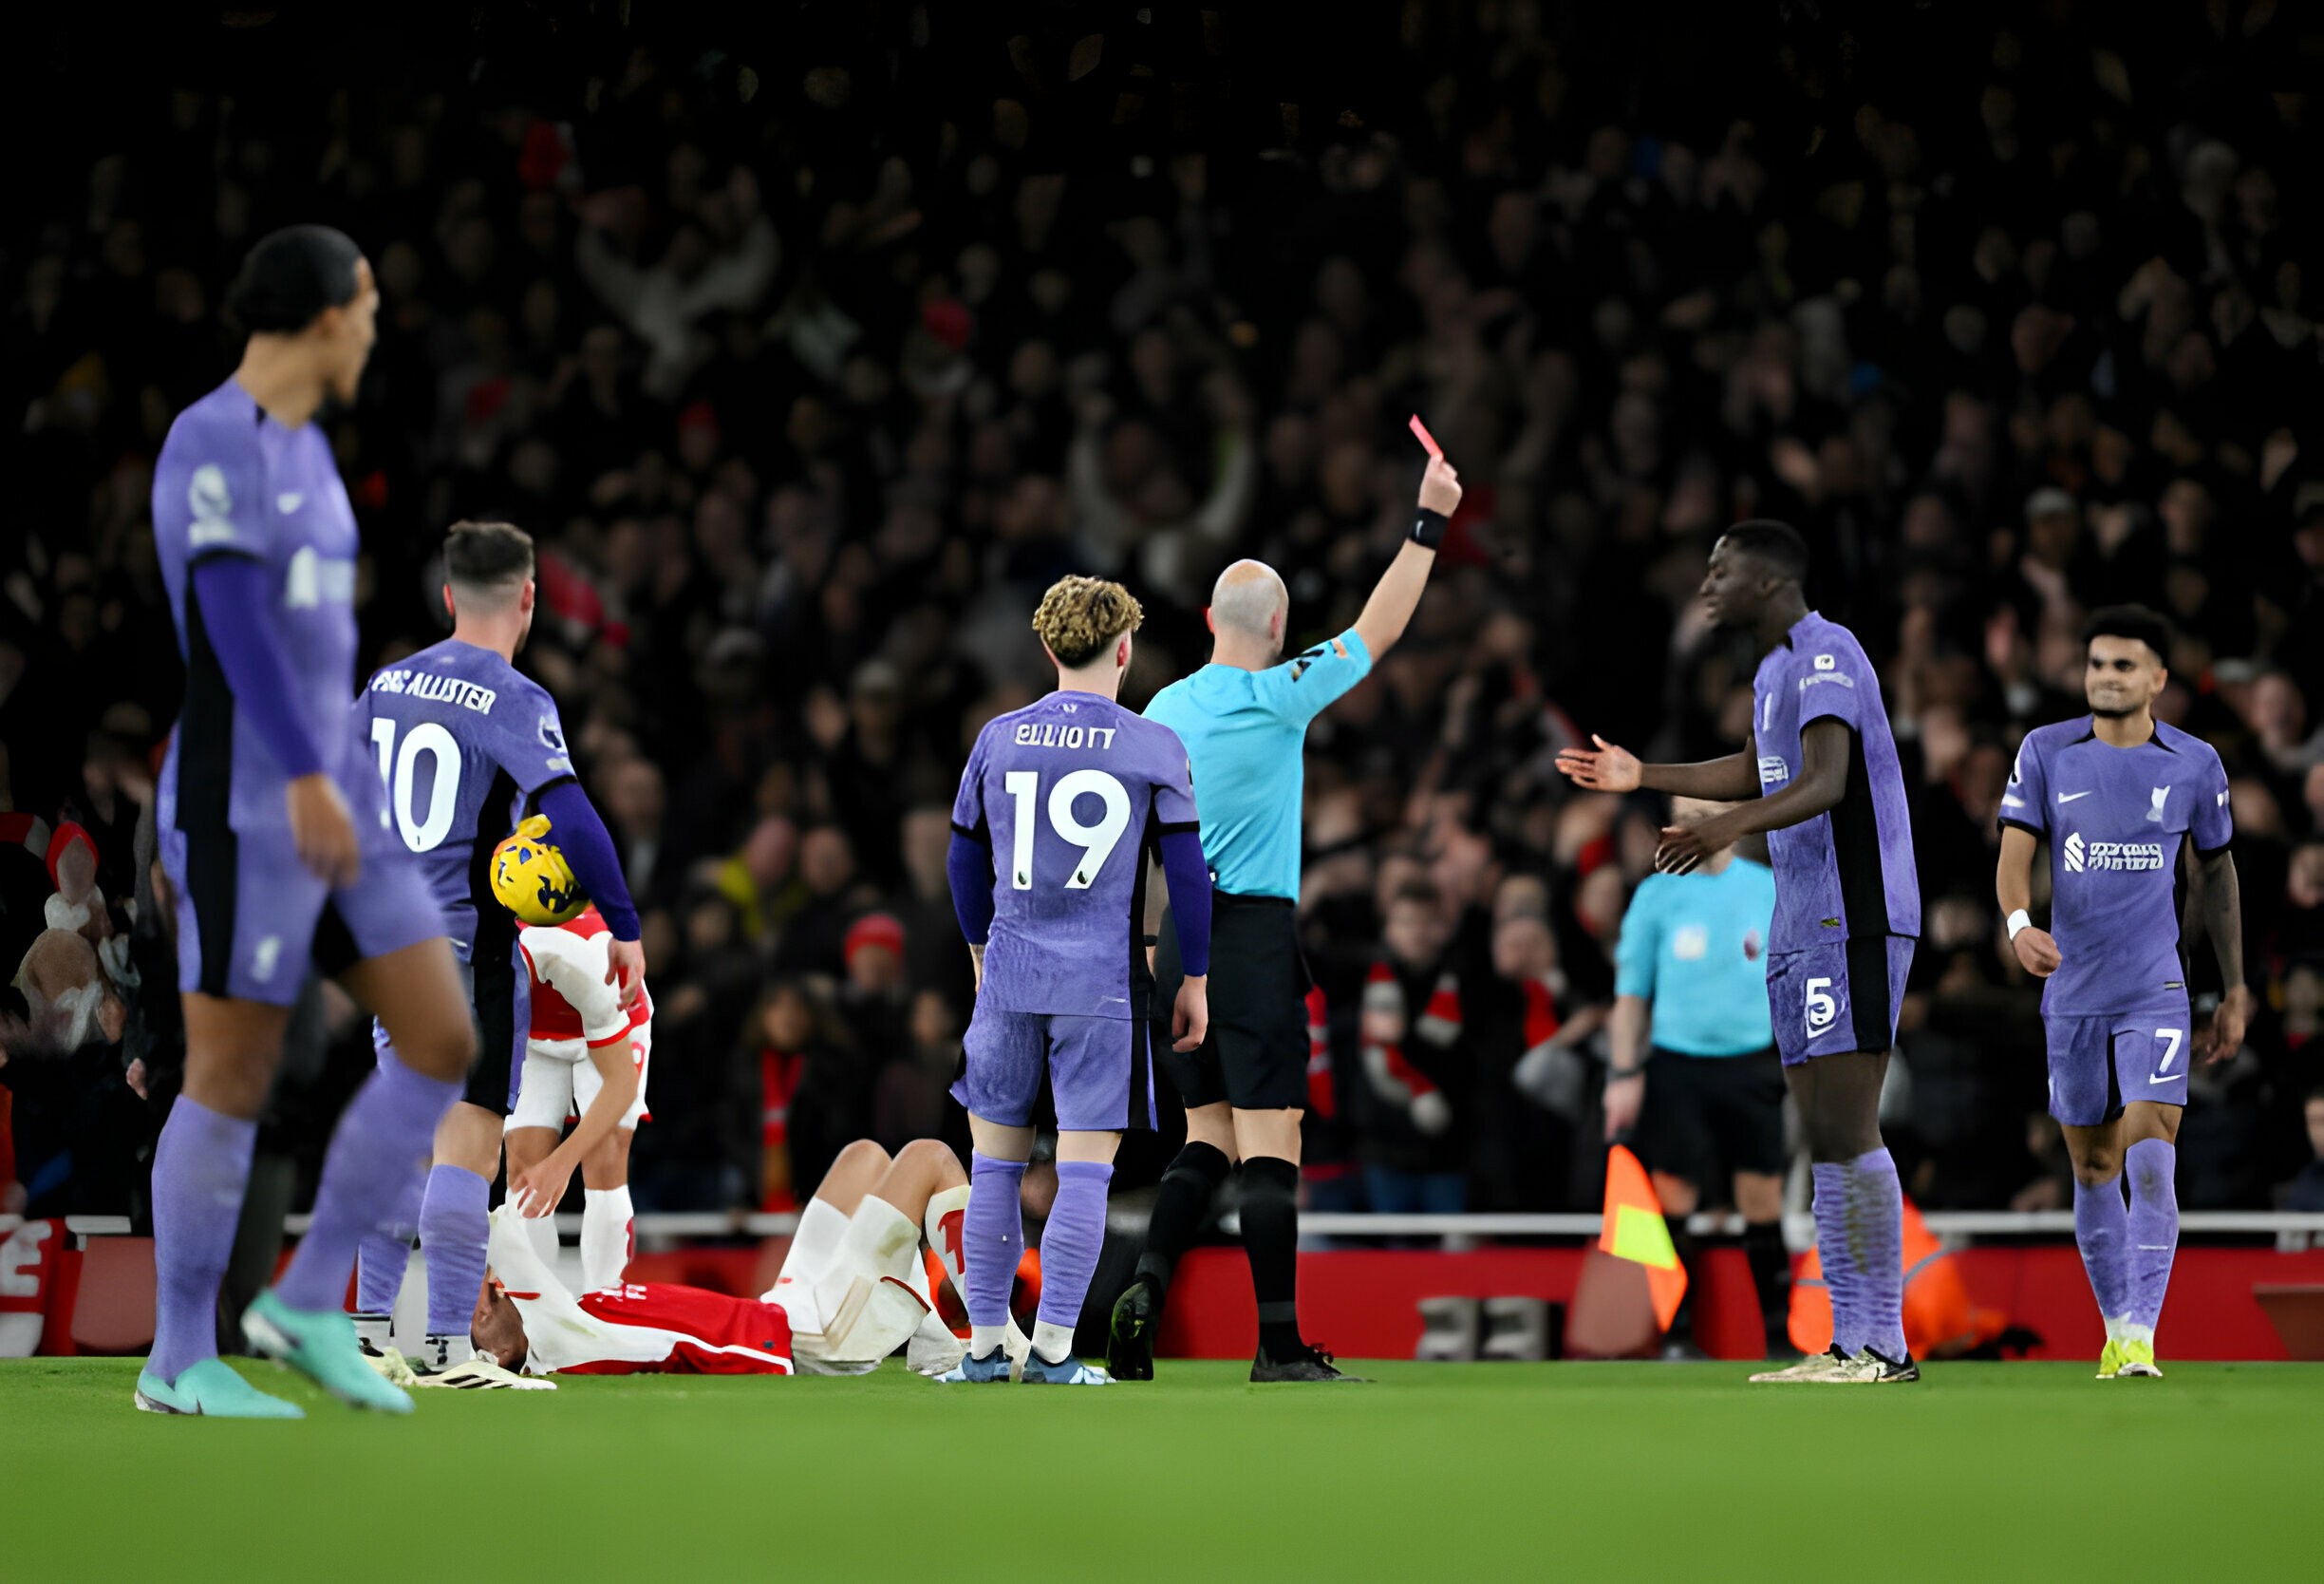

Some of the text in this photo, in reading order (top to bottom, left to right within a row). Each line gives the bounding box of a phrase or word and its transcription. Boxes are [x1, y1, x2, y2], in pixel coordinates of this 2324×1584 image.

[371, 717, 461, 853] 10
[1005, 769, 1132, 890] 19
[1807, 977, 1836, 1026] 5
[2155, 1028, 2183, 1073] 7
